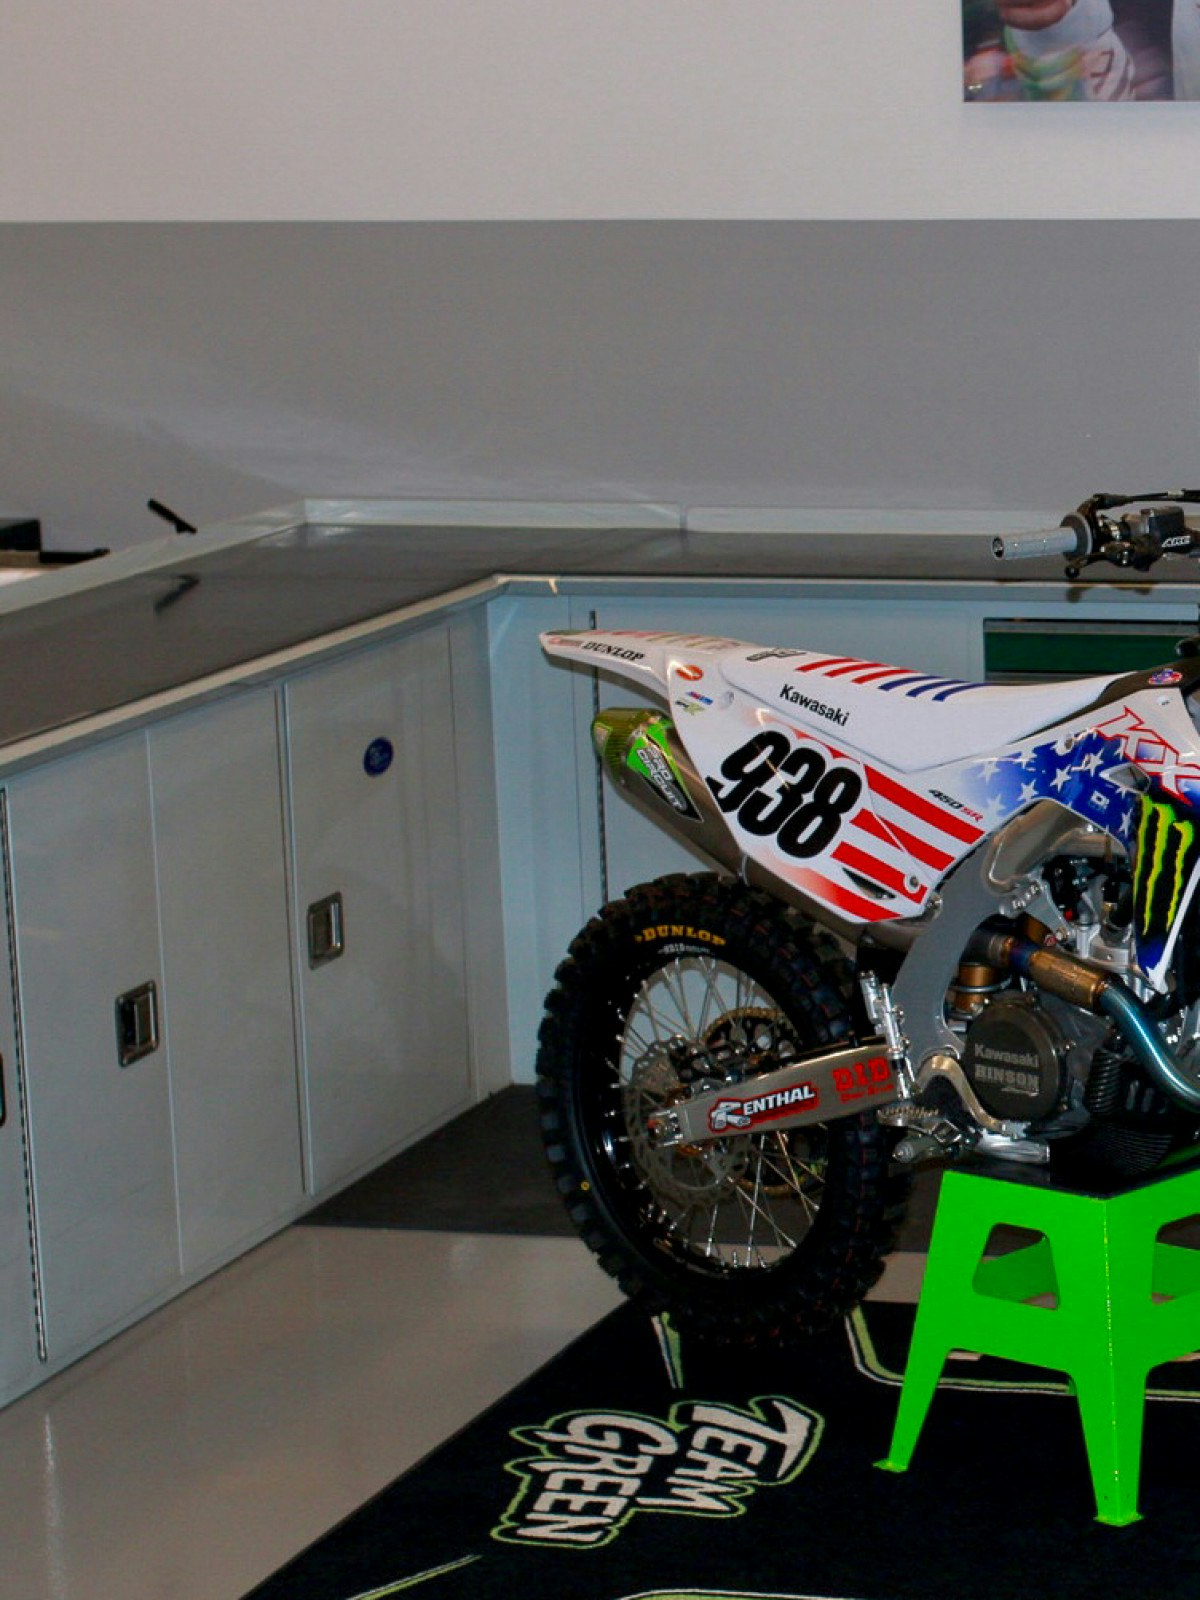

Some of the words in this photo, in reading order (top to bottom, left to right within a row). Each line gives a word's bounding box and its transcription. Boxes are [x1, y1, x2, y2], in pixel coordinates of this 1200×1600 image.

[582, 640, 646, 661] DUNLOP
[779, 684, 851, 728] Kawasaki
[704, 730, 863, 859] 938
[641, 924, 727, 946] DUNLOP
[974, 1043, 1040, 1068] Kawasaki
[515, 1414, 679, 1542] GREEN
[634, 1400, 812, 1512] TEAM
